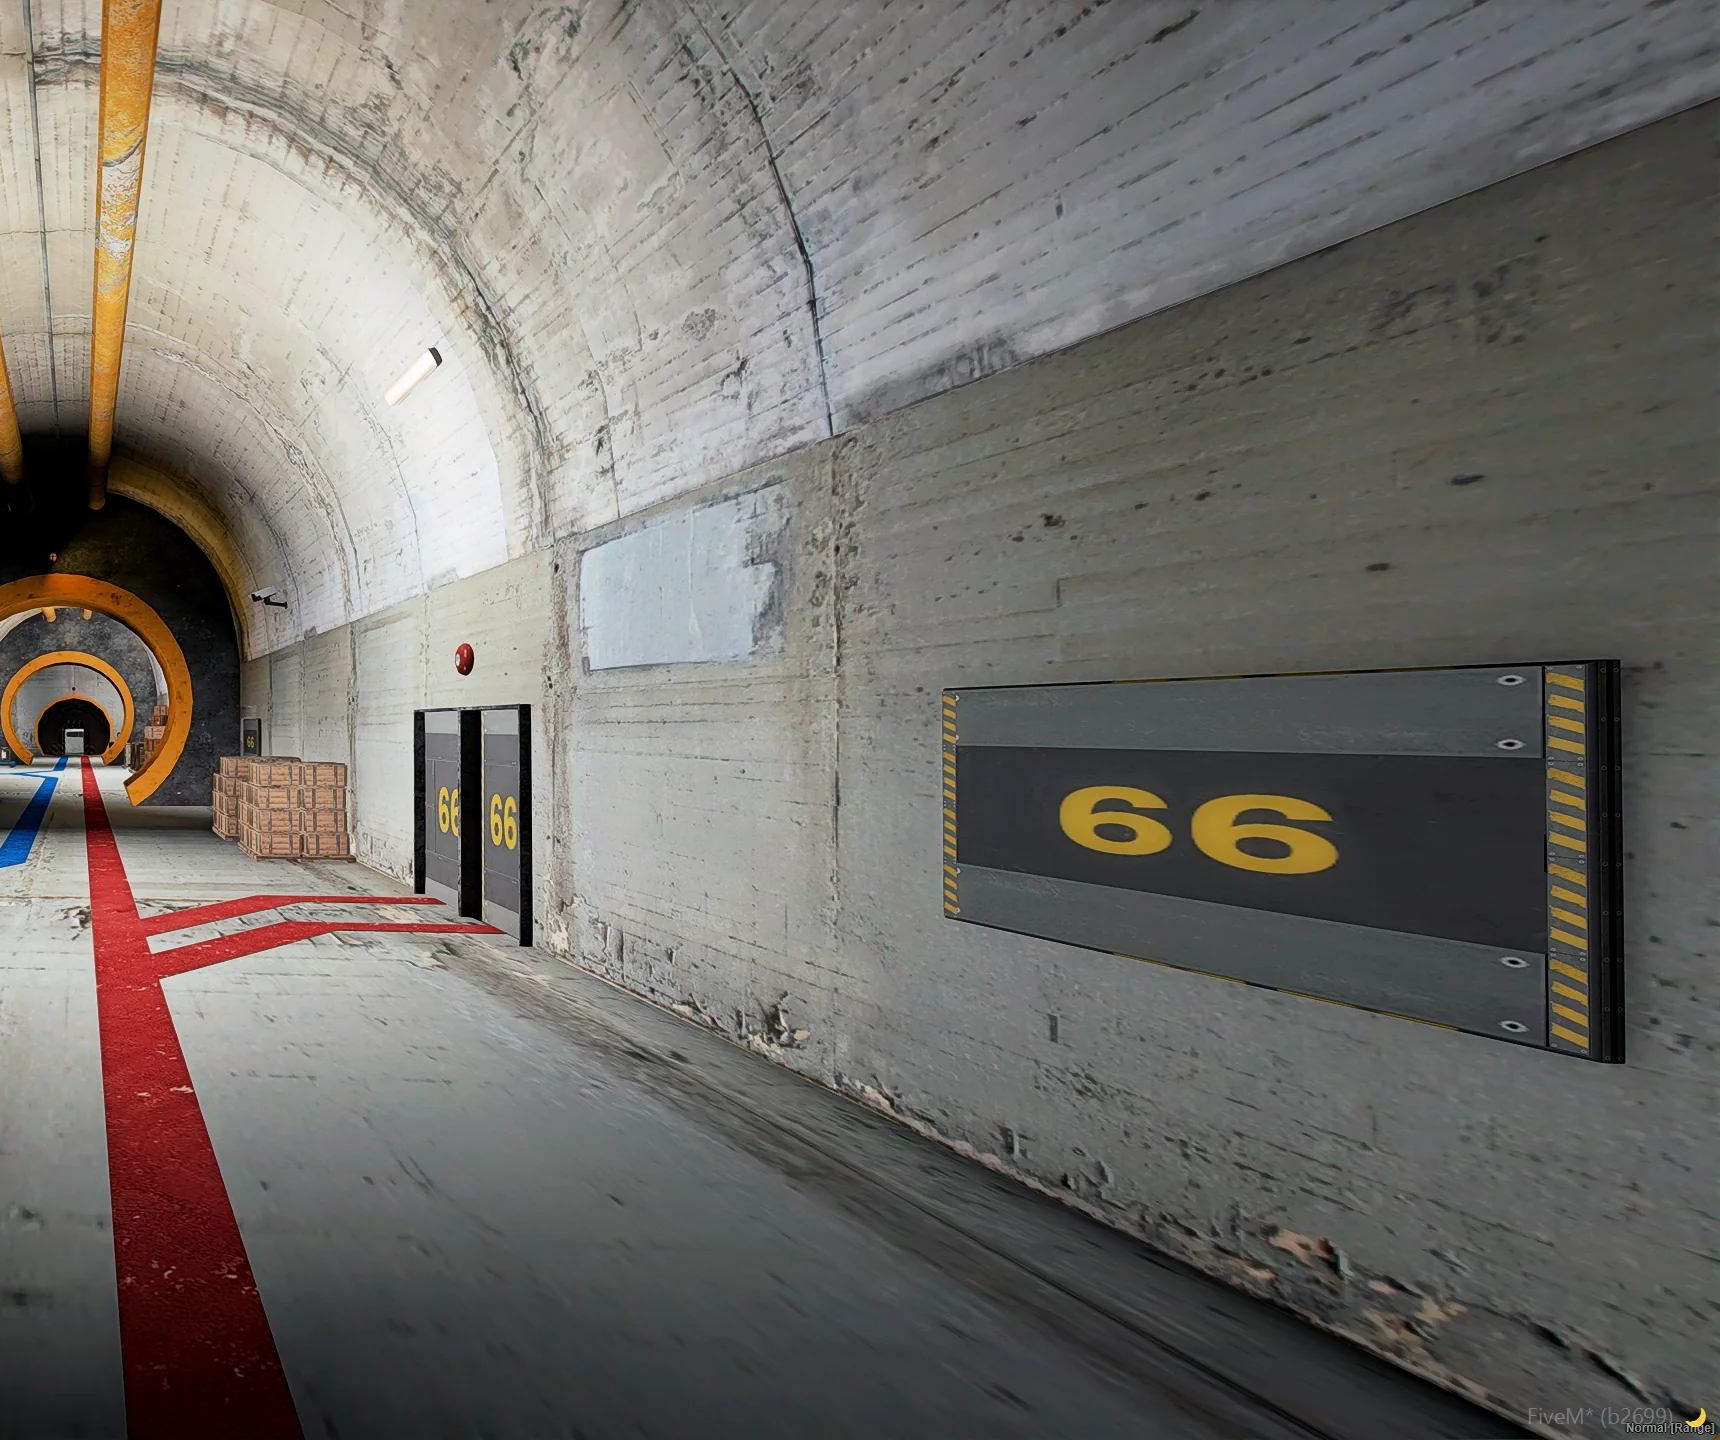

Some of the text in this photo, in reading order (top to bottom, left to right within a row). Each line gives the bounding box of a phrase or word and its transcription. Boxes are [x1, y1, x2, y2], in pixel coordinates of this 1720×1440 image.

[438, 786, 459, 837] 66
[490, 793, 518, 851] 66
[1059, 784, 1340, 875] 66
